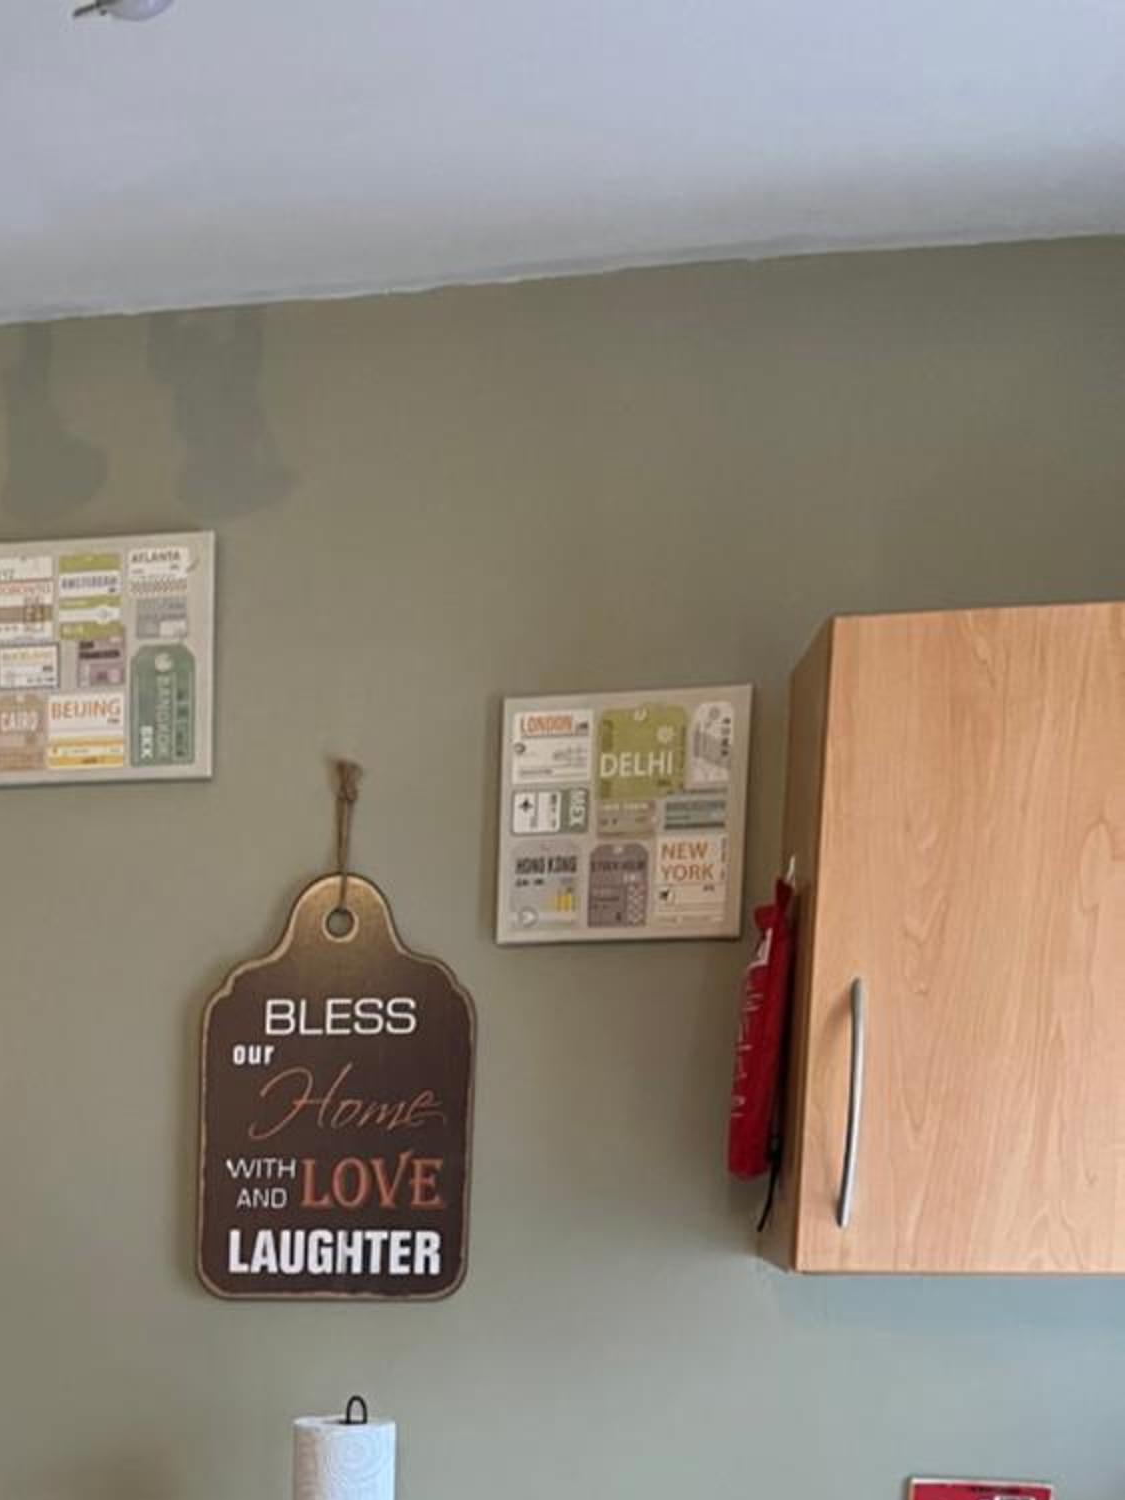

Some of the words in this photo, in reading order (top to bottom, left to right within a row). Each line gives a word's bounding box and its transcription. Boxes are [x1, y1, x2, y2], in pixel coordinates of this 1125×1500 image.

[131, 550, 182, 564] ATLANTA
[52, 698, 122, 720] BEIJING
[520, 714, 574, 737] LONDON
[600, 751, 673, 778] DELHI
[660, 842, 709, 861] NEW
[659, 863, 715, 881] YORK
[264, 997, 418, 1036] BLESS
[232, 1043, 276, 1066] our
[248, 1061, 447, 1141] Home
[226, 1158, 296, 1180] WITH
[299, 1149, 444, 1210] LOVE
[236, 1187, 288, 1209] AND
[228, 1228, 441, 1276] LAUGHTER
